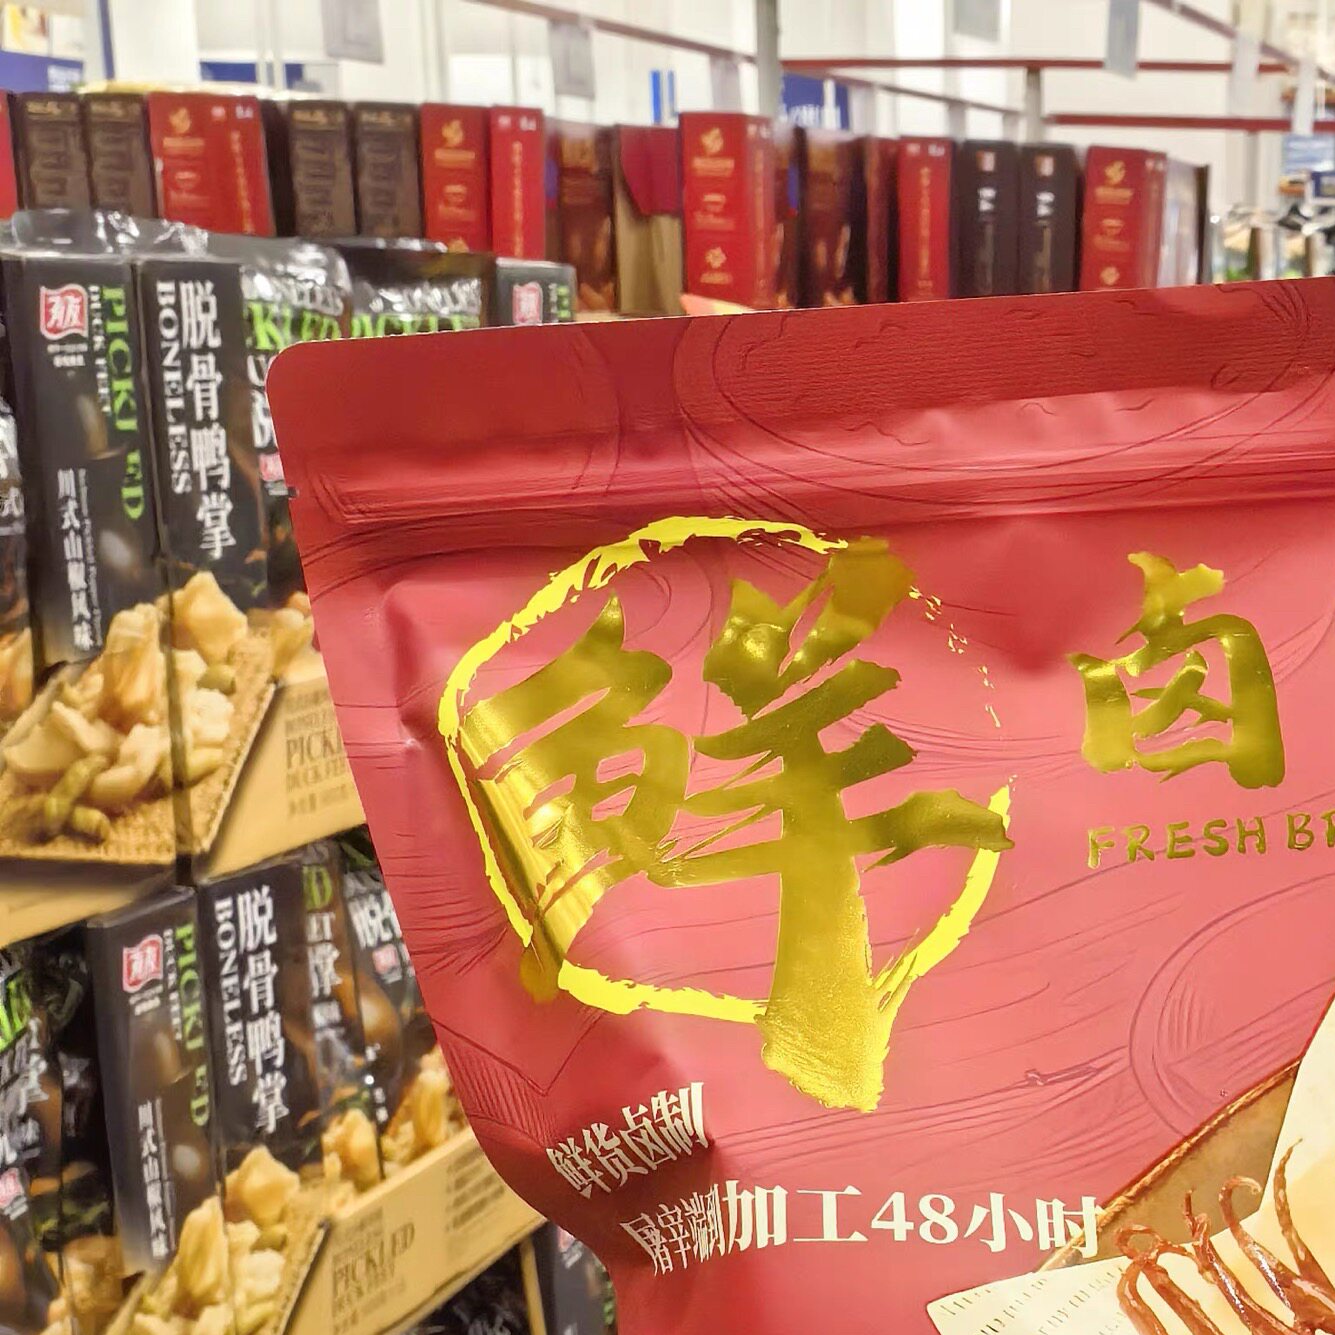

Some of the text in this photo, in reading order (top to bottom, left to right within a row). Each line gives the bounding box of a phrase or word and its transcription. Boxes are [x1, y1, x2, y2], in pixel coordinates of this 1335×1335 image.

[157, 281, 193, 494] BONELESS
[179, 280, 237, 560] 脱骨鸭掌
[460, 536, 1016, 1114] 鲜
[1087, 817, 1268, 869] FRESH
[215, 900, 247, 1086] BONELESS
[546, 1081, 709, 1200] 鲜货卤制
